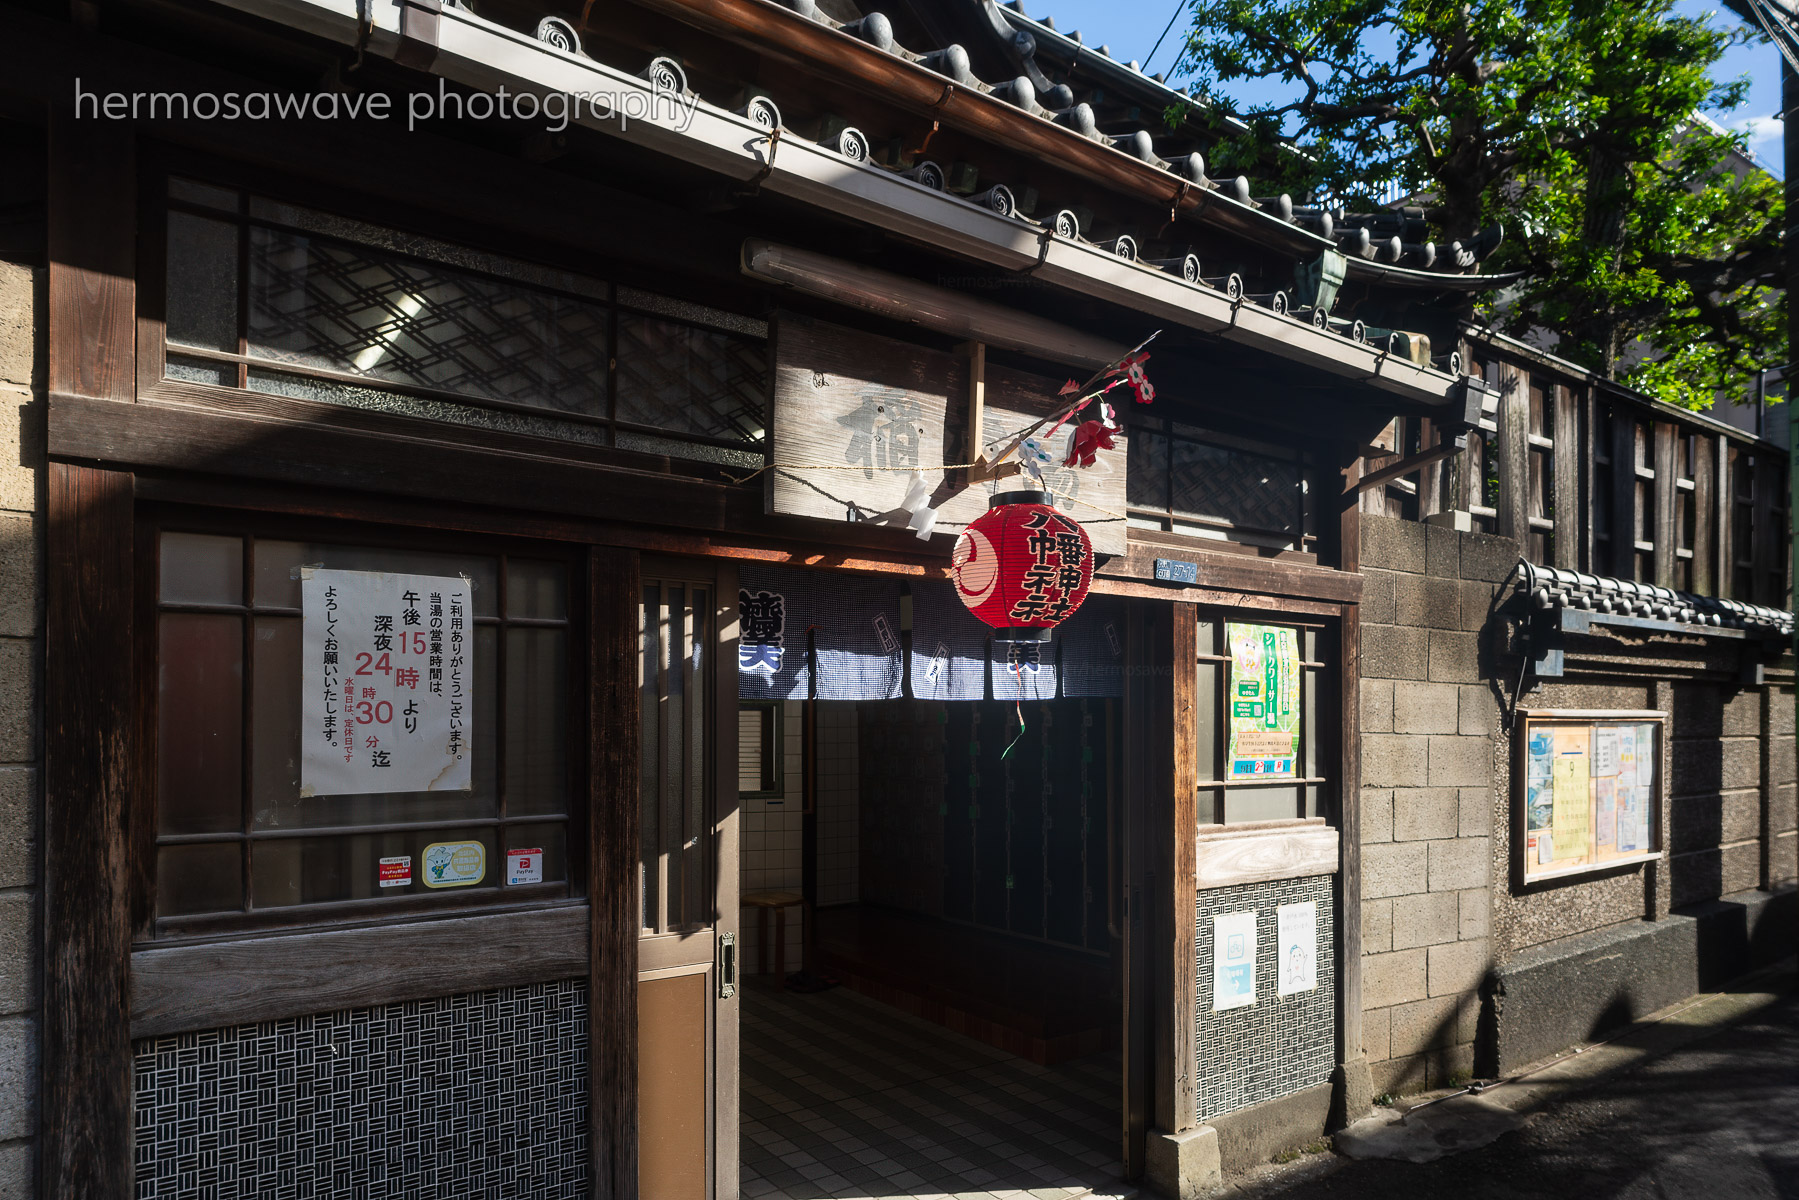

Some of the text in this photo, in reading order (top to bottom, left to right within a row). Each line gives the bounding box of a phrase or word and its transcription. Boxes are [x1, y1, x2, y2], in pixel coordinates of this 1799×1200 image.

[322, 585, 338, 748] よろしくお願いいたします。
[429, 592, 443, 698] 当湯の営業時間は、
[450, 592, 463, 761] ご利用ありがとうございます。
[1264, 633, 1276, 725] シークワーサー湯
[344, 677, 355, 763] 水曜日は、定休日です
